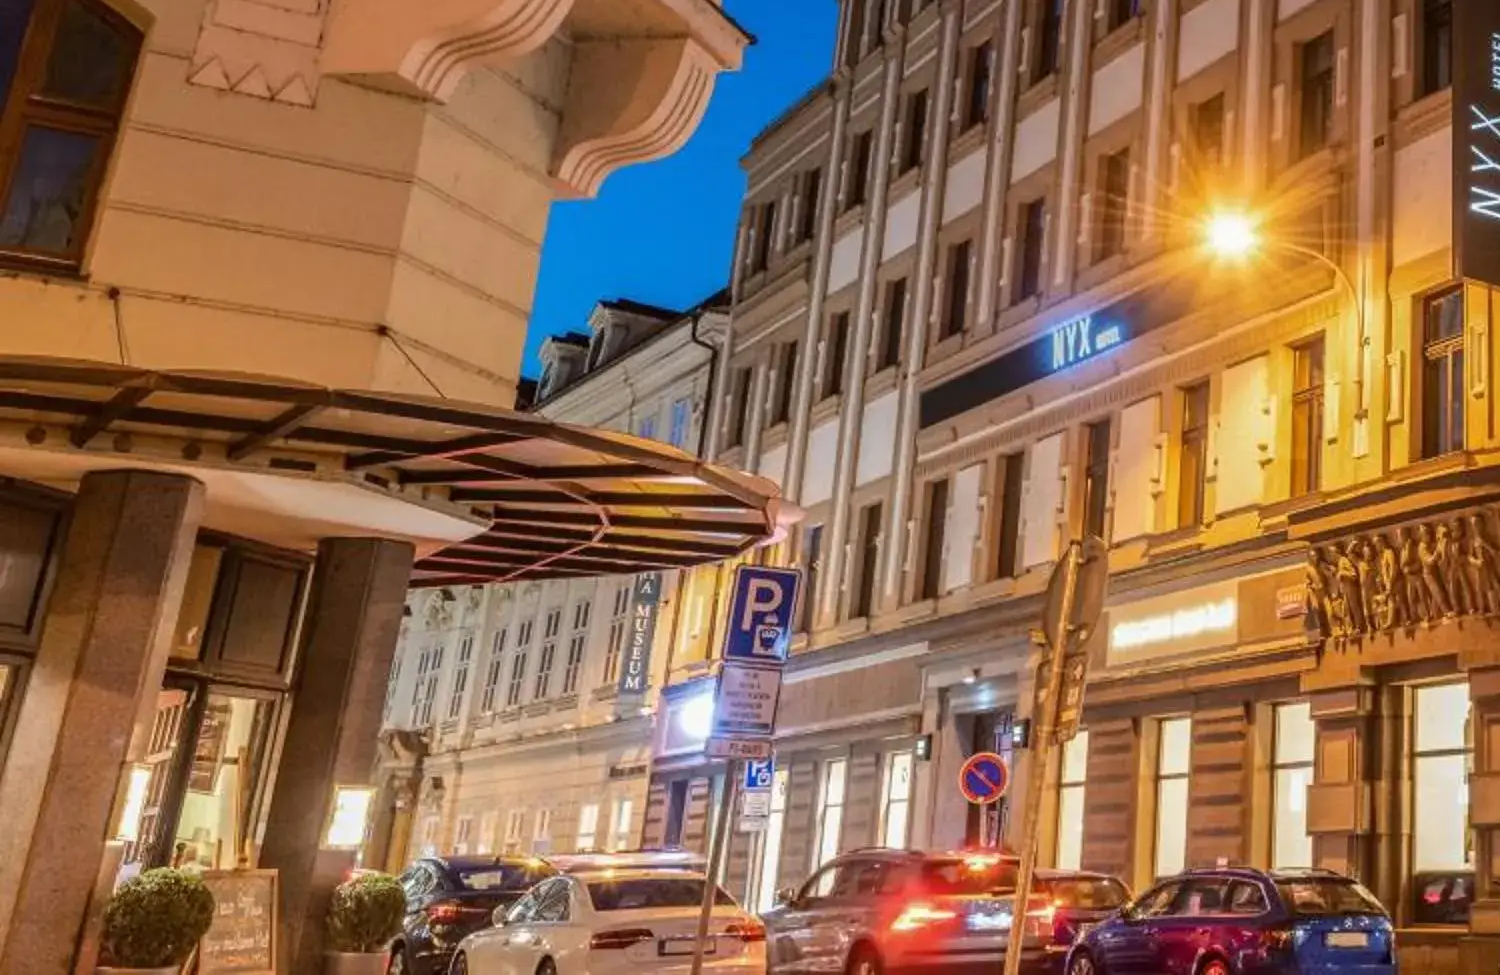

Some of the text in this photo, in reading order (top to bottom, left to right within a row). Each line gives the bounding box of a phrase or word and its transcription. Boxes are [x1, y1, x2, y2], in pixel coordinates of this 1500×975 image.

[1052, 316, 1092, 370] NYX
[741, 577, 784, 632] P
[624, 604, 651, 690] MUSEUM
